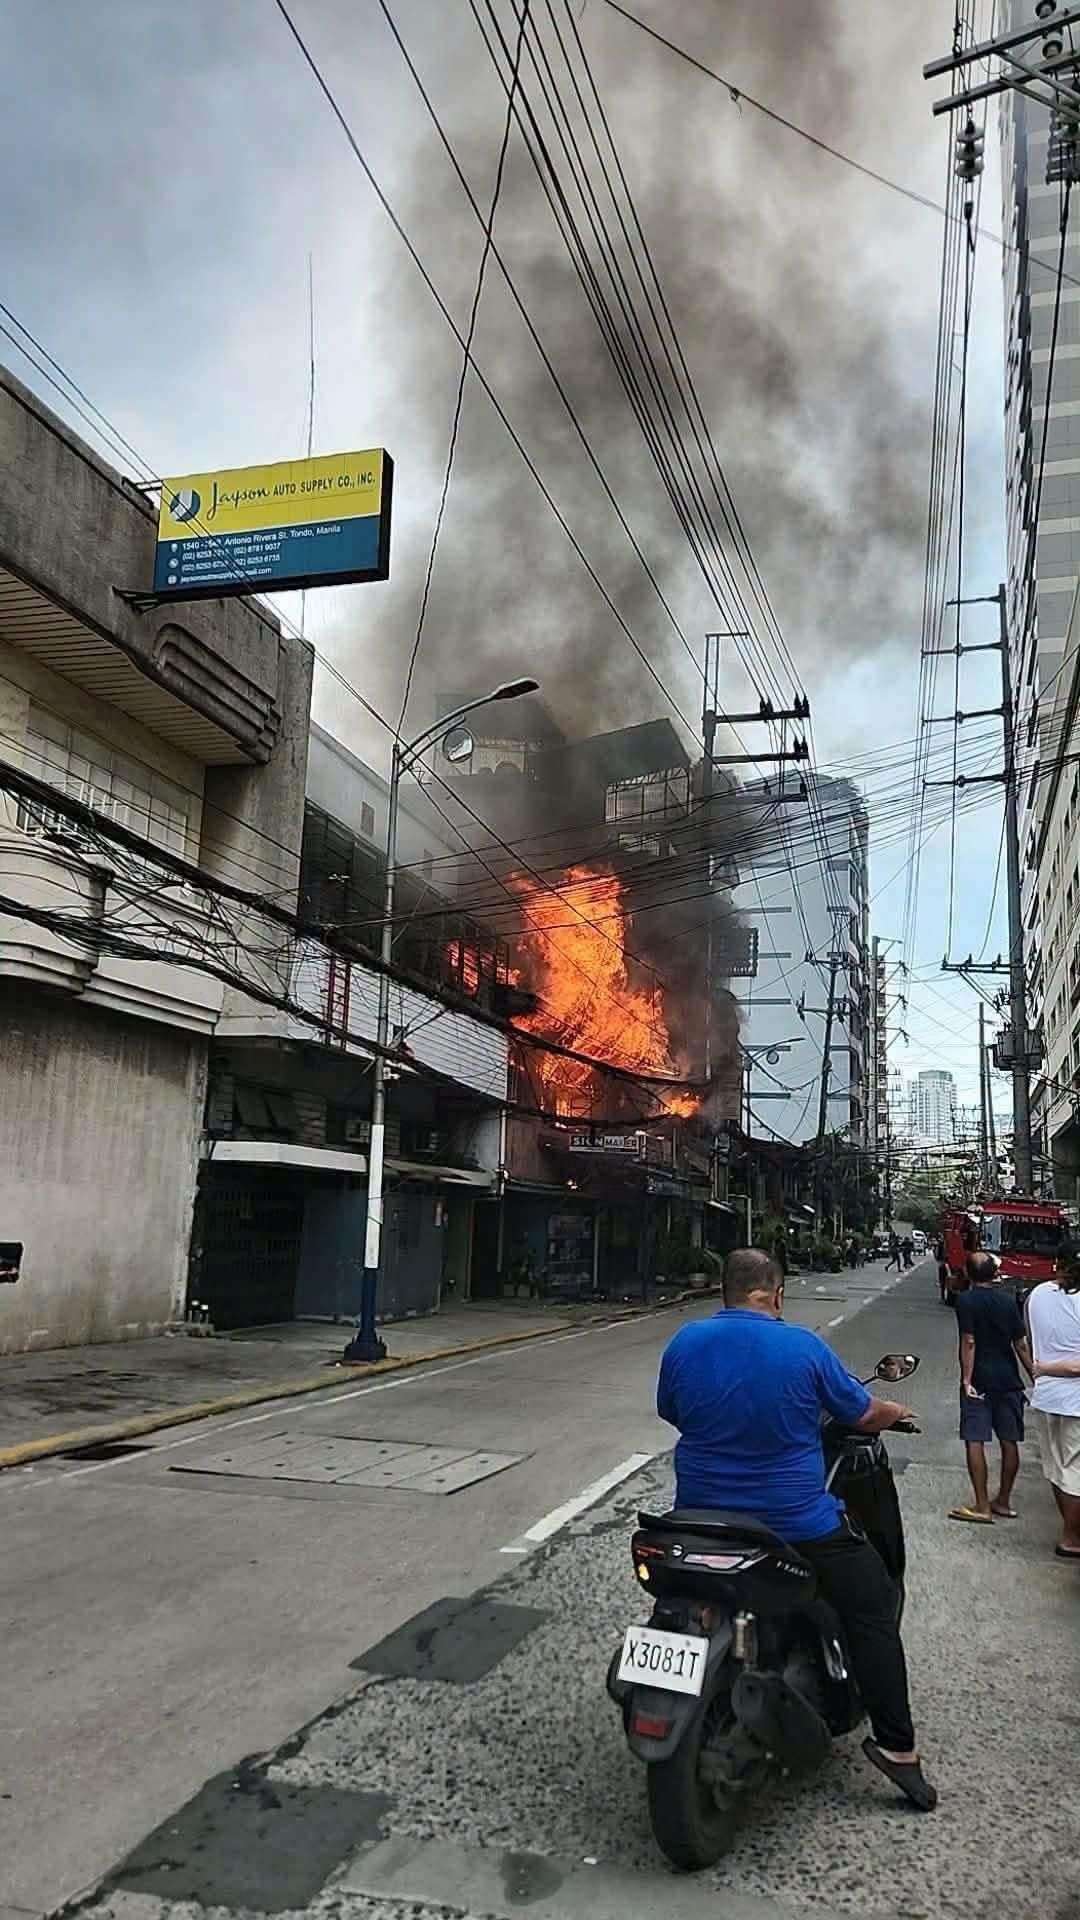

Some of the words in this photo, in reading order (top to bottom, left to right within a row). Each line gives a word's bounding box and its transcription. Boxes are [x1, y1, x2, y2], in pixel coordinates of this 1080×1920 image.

[206, 481, 270, 520] Jayson
[273, 485, 296, 496] AUTO
[300, 479, 332, 493] SUPPLY
[357, 472, 375, 486] INC.
[224, 536, 252, 546] Antonio
[253, 533, 277, 543] Rivera
[316, 525, 341, 535] Manila
[624, 1639, 700, 1680] X3081T
